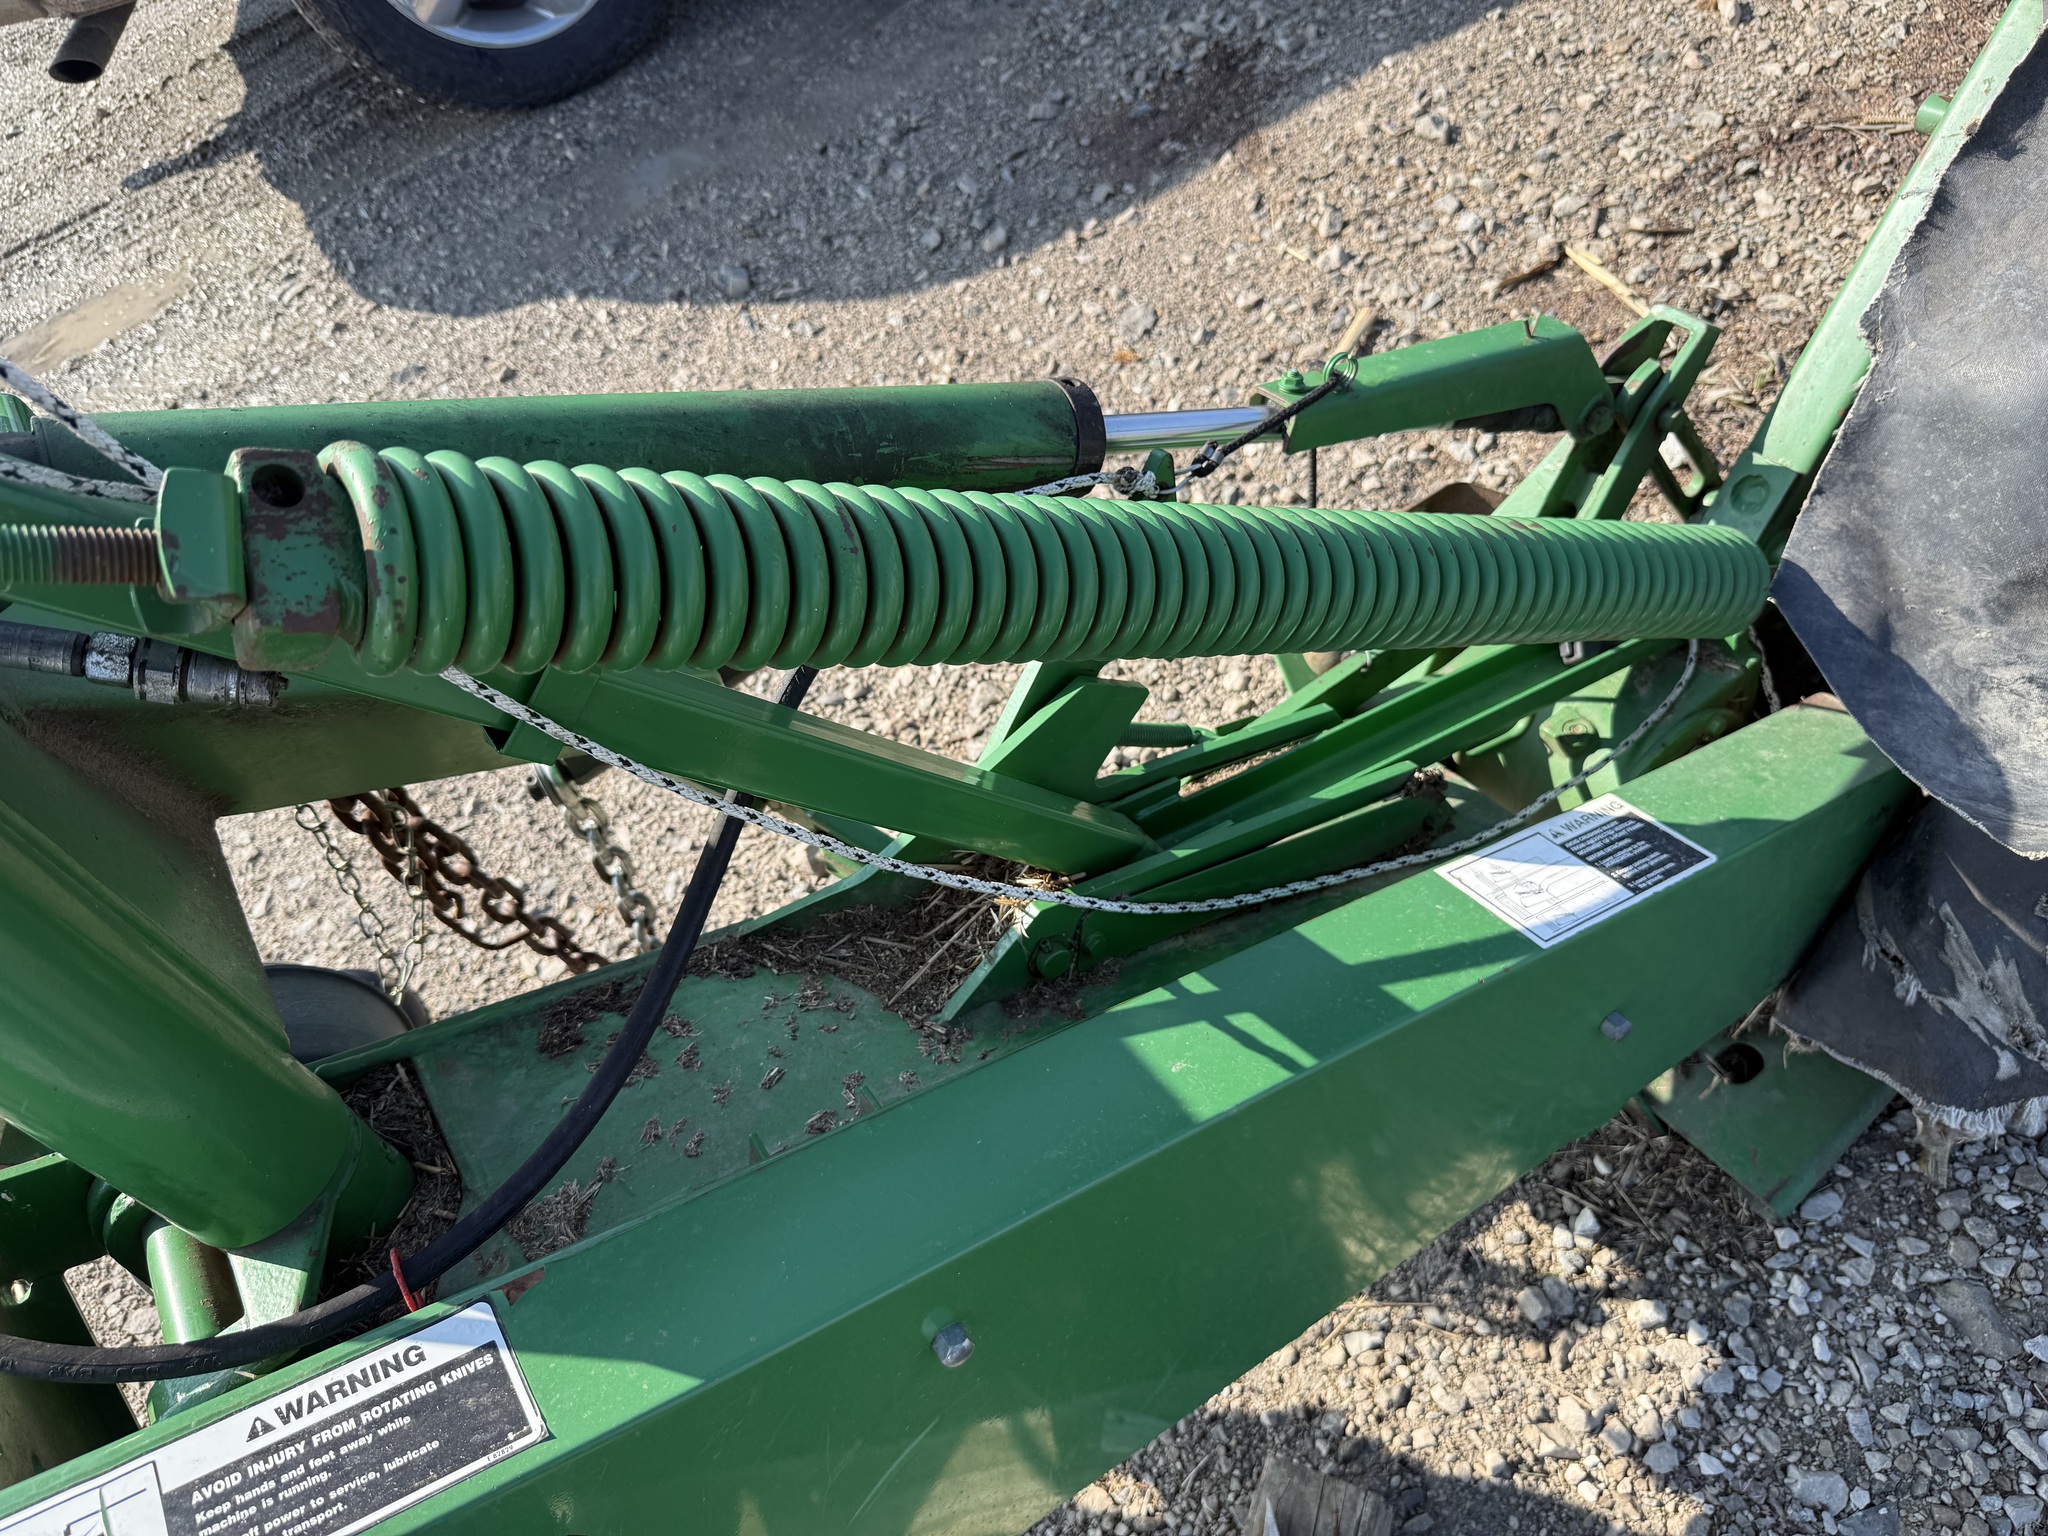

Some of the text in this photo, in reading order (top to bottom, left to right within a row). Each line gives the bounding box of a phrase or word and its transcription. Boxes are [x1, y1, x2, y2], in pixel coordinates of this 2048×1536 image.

[1561, 801, 1623, 831] WARNING
[274, 1346, 426, 1425] WARNING
[192, 1353, 494, 1505] AVOID INJURY FROM ROTATING KNIVES
[195, 1416, 411, 1525] Keep hands and feet away while
[198, 1471, 332, 1536] machine is running.
[264, 1505, 305, 1534] power
[310, 1497, 324, 1509] to
[329, 1472, 380, 1499] service,
[383, 1440, 439, 1473] lubricate
[282, 1502, 347, 1536] transport.
